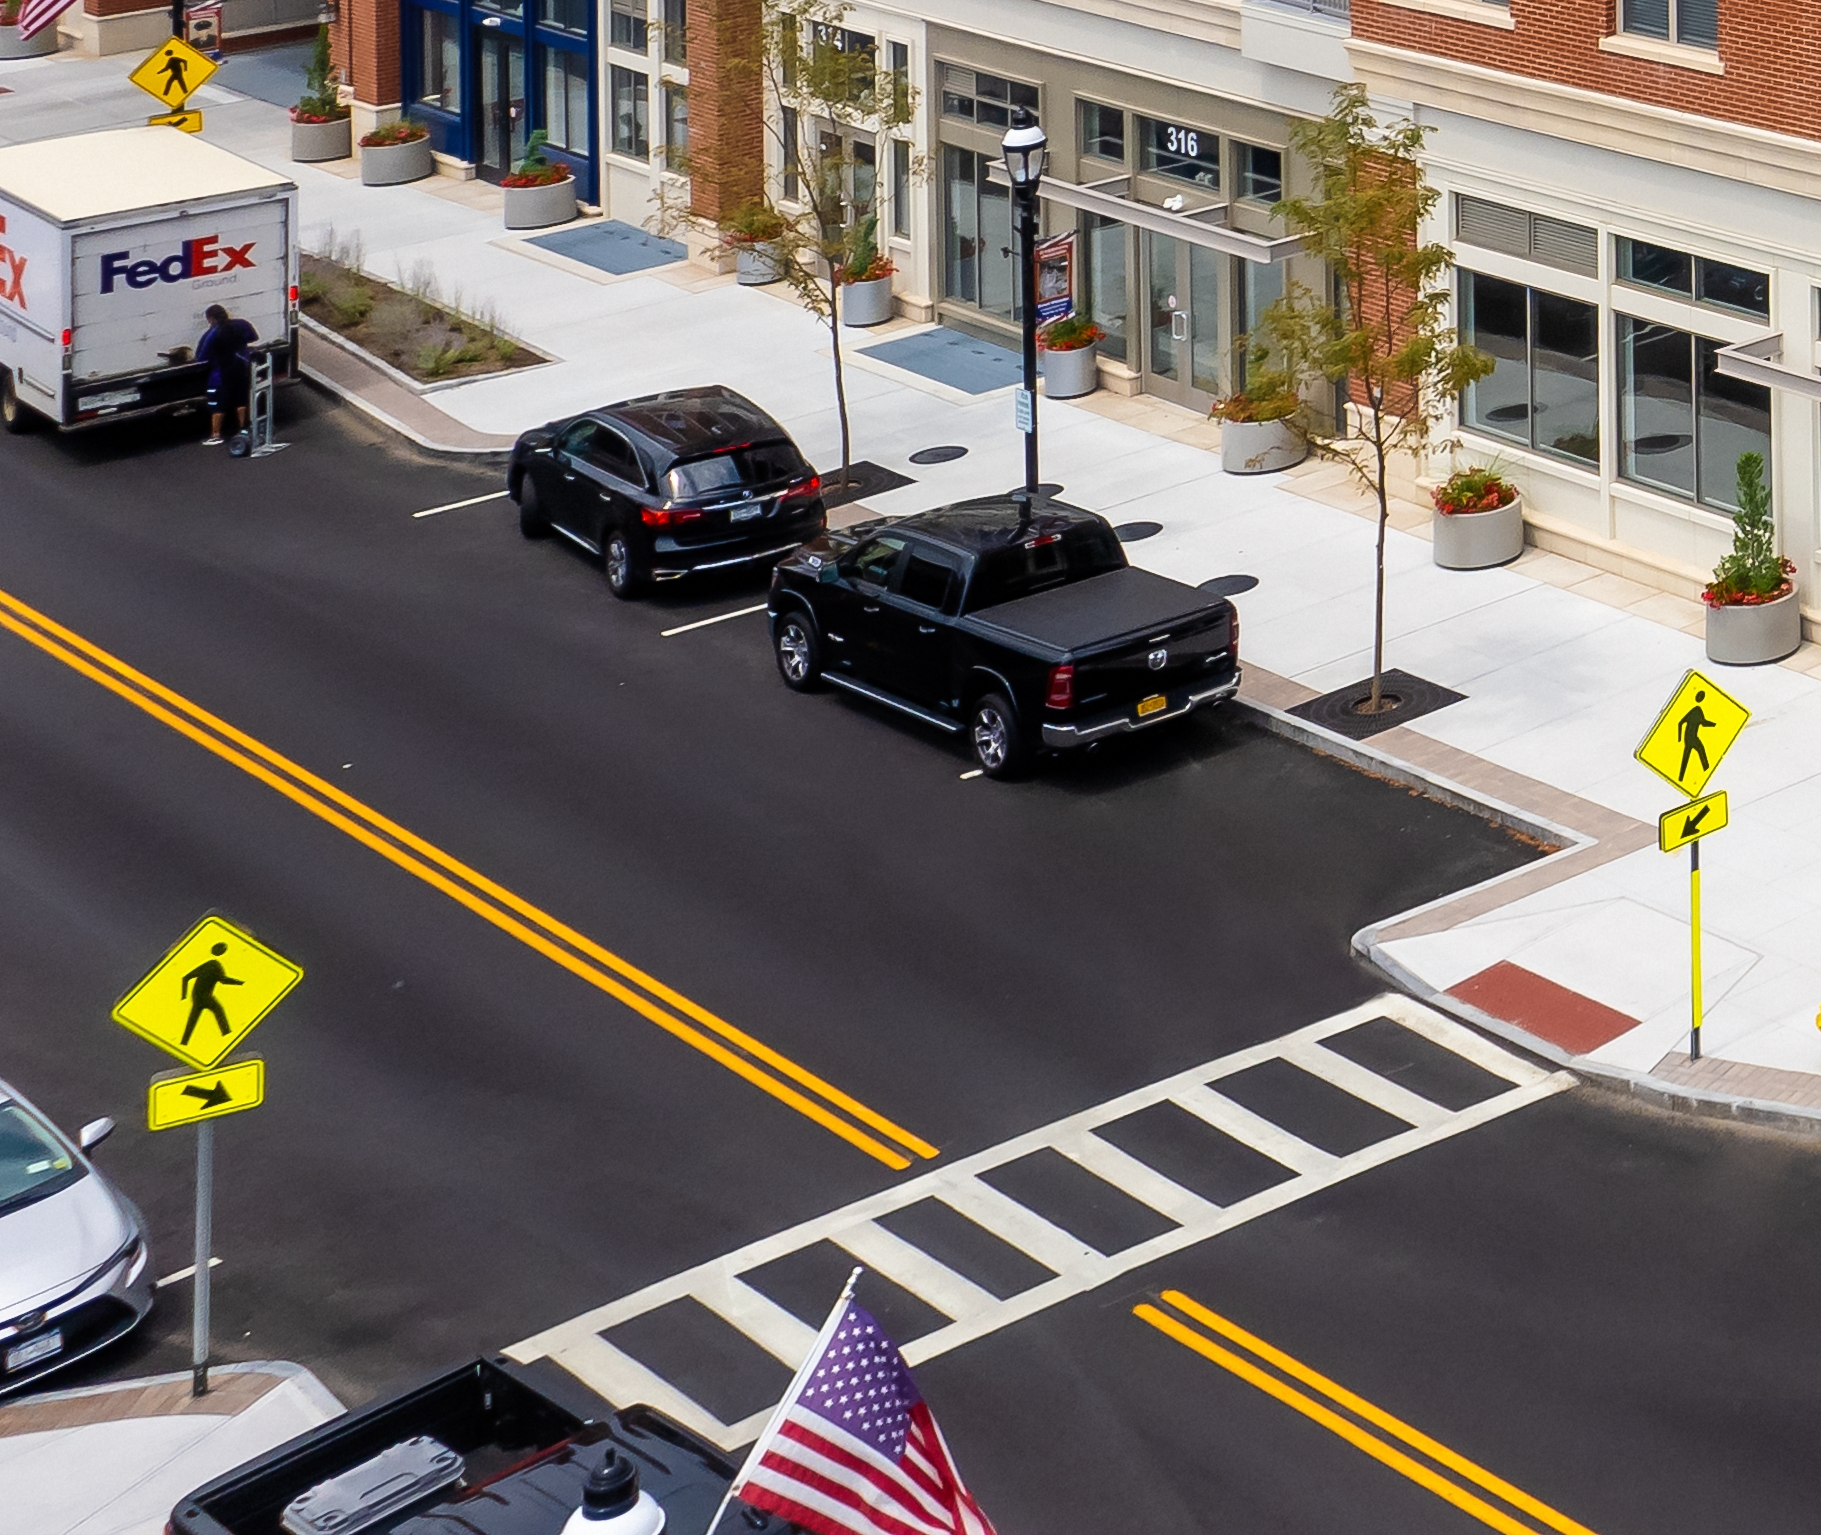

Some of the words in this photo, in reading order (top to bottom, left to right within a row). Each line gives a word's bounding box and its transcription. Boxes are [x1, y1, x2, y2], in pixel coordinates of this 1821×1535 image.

[1167, 126, 1198, 157] 316
[100, 234, 257, 295] FedEx
[192, 273, 238, 290] Ground
